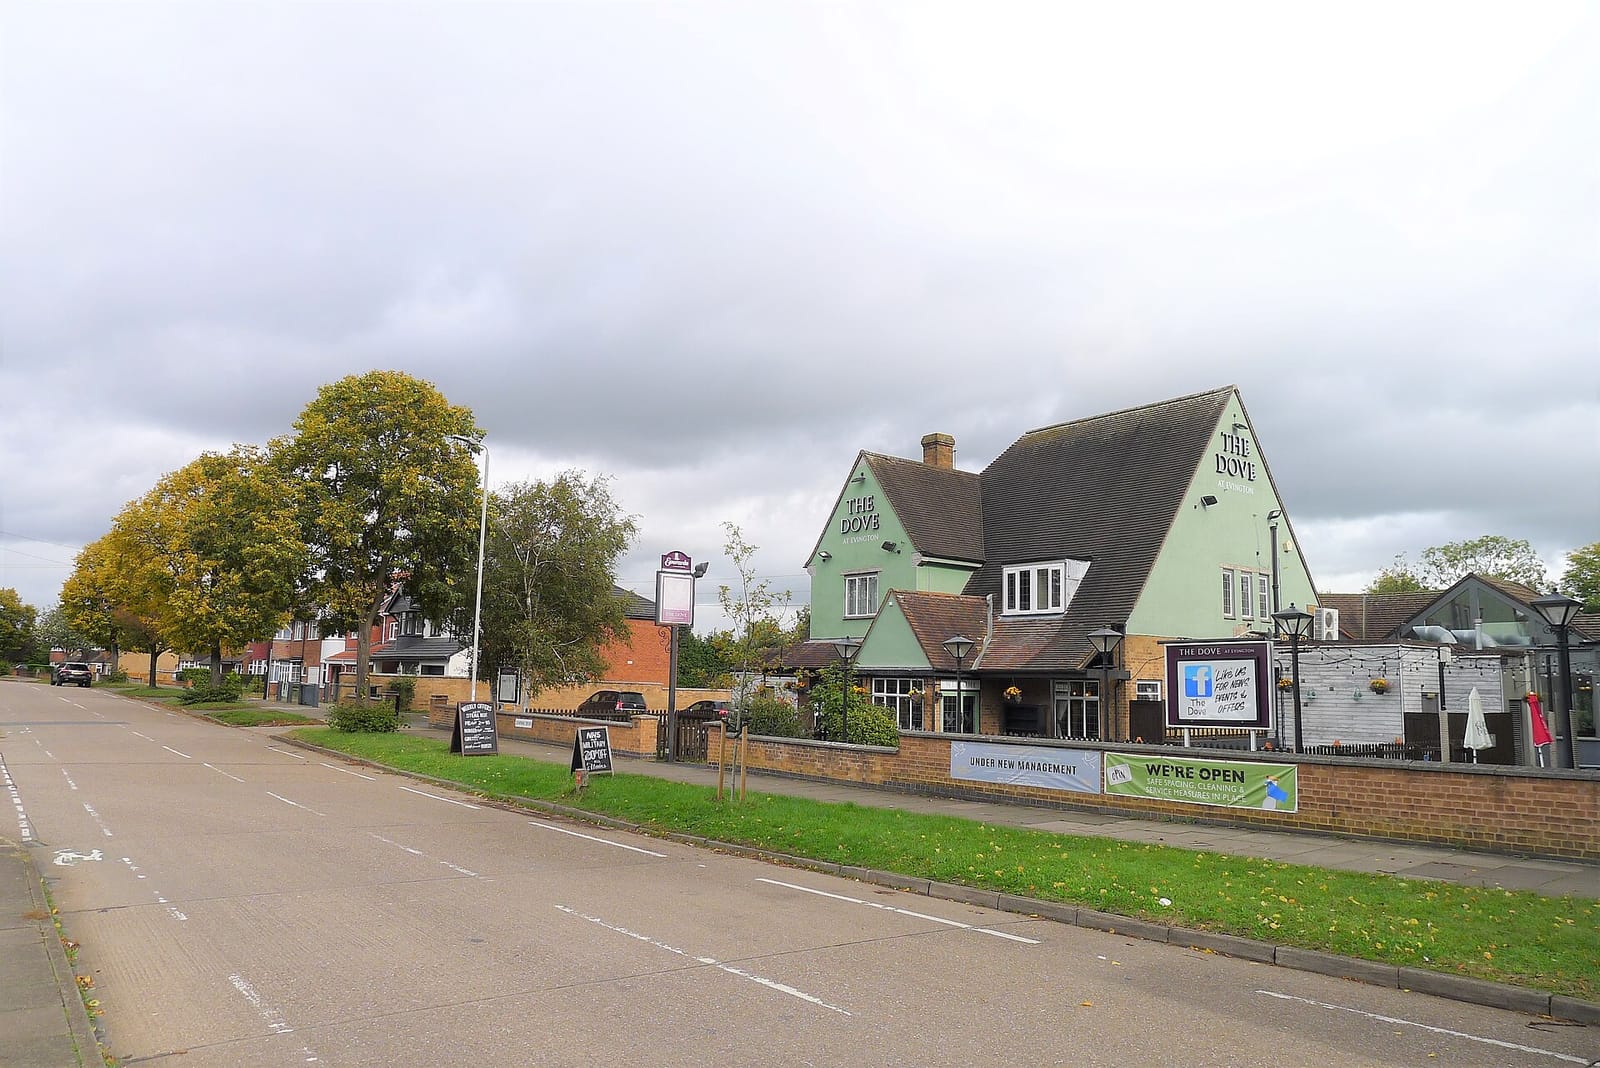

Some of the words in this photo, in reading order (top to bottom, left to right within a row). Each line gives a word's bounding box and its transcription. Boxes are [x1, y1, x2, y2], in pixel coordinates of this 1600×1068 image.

[1220, 432, 1250, 457] THE
[1216, 454, 1256, 482] DOVE
[846, 495, 875, 514] THE
[840, 513, 880, 534] DOVE
[850, 534, 880, 544] EVINGTON
[1198, 648, 1222, 656] DOVE
[1214, 682, 1228, 692] FOR
[1191, 698, 1206, 707] The
[1214, 691, 1238, 703] EVENTS
[1188, 706, 1206, 716] Dove
[1218, 702, 1245, 714] OFFERS
[970, 757, 995, 768] UNDER
[998, 759, 1014, 769] NEW
[1018, 761, 1077, 775] MANAGEMENT
[1146, 763, 1194, 779] WE'RE
[1199, 768, 1245, 783] OPEN
[1147, 778, 1163, 786] SAFE
[1164, 779, 1196, 790] SPACING,
[1198, 782, 1237, 792] CLEANING
[1145, 786, 1172, 795] SERVICE
[1174, 789, 1210, 800] MEASURES
[1222, 794, 1246, 802] PLACE
